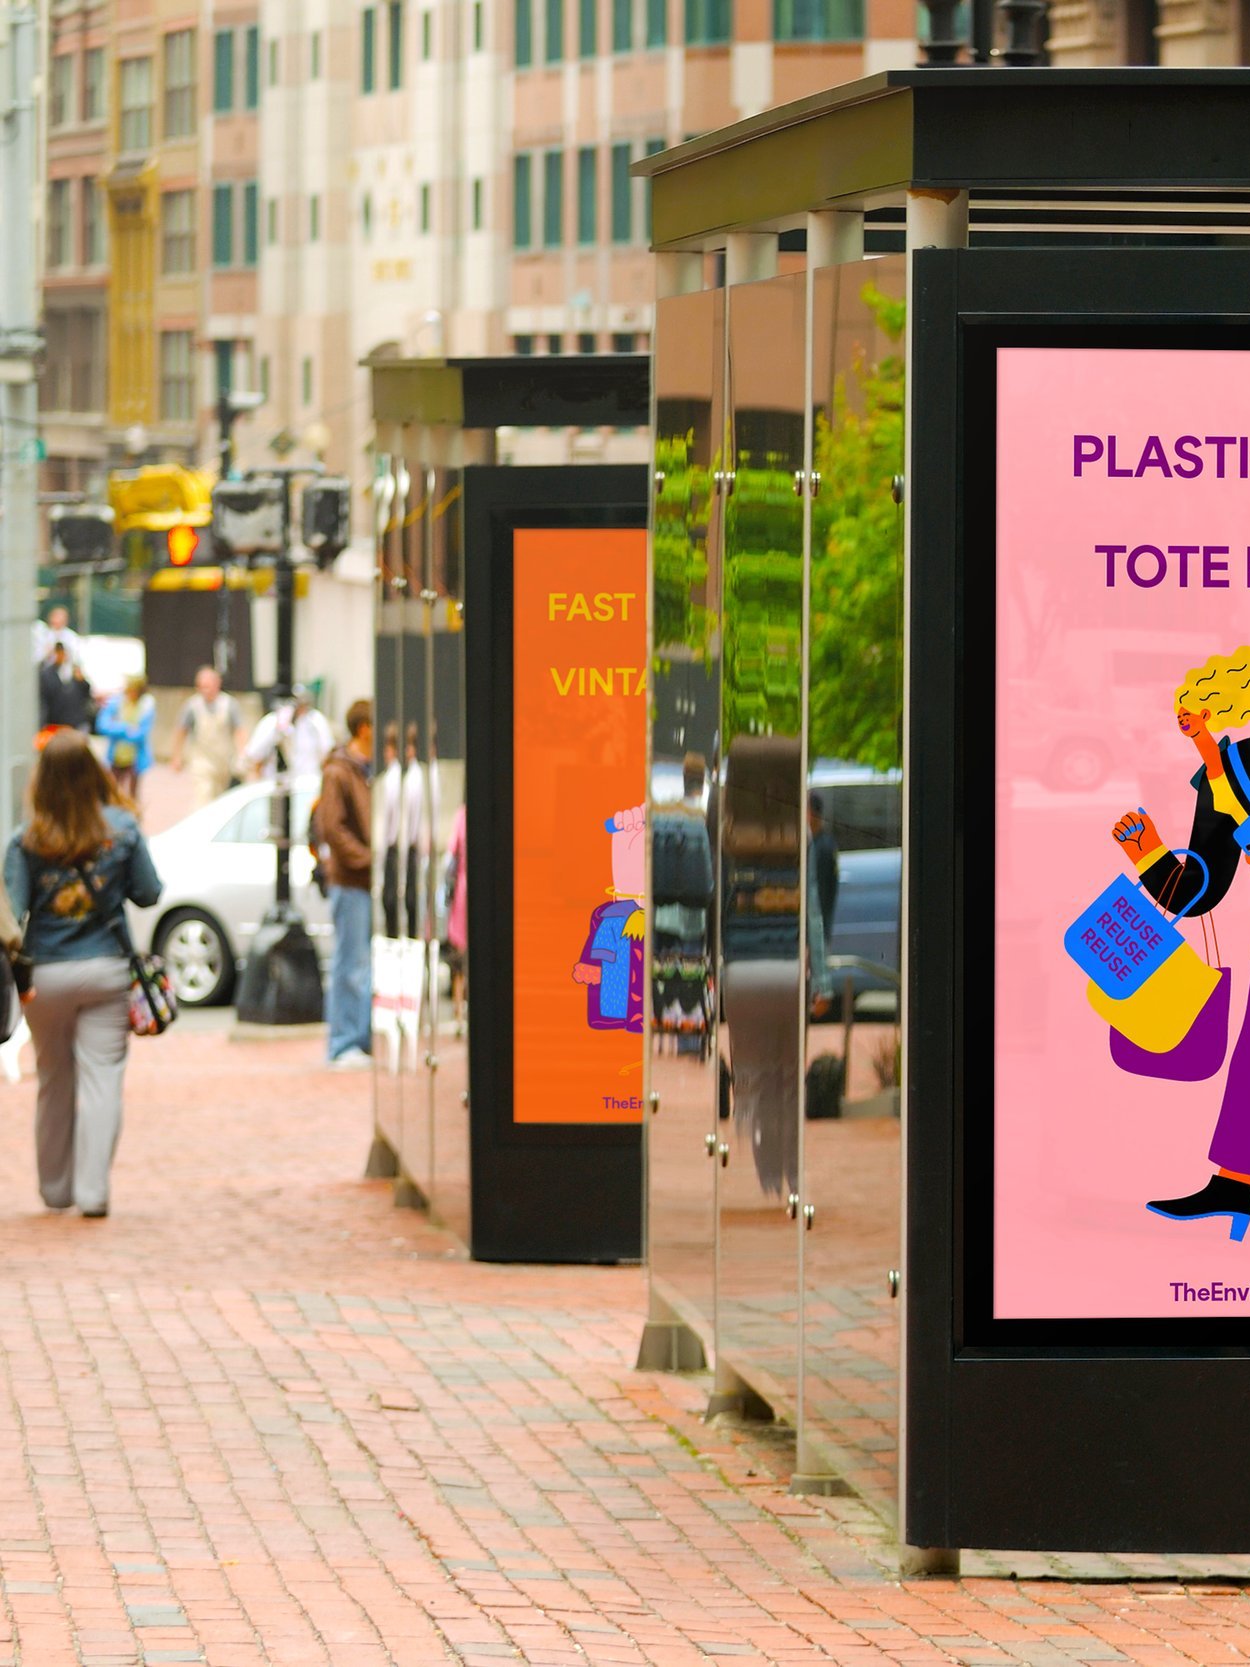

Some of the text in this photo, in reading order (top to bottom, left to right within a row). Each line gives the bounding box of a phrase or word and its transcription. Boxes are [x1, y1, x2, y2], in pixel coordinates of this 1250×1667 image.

[1094, 544, 1230, 589] TOTE
[548, 592, 636, 622] FAST
[1096, 911, 1149, 967] REUSE
[1111, 895, 1164, 951] REUSE
[1080, 927, 1133, 982] REUSE
